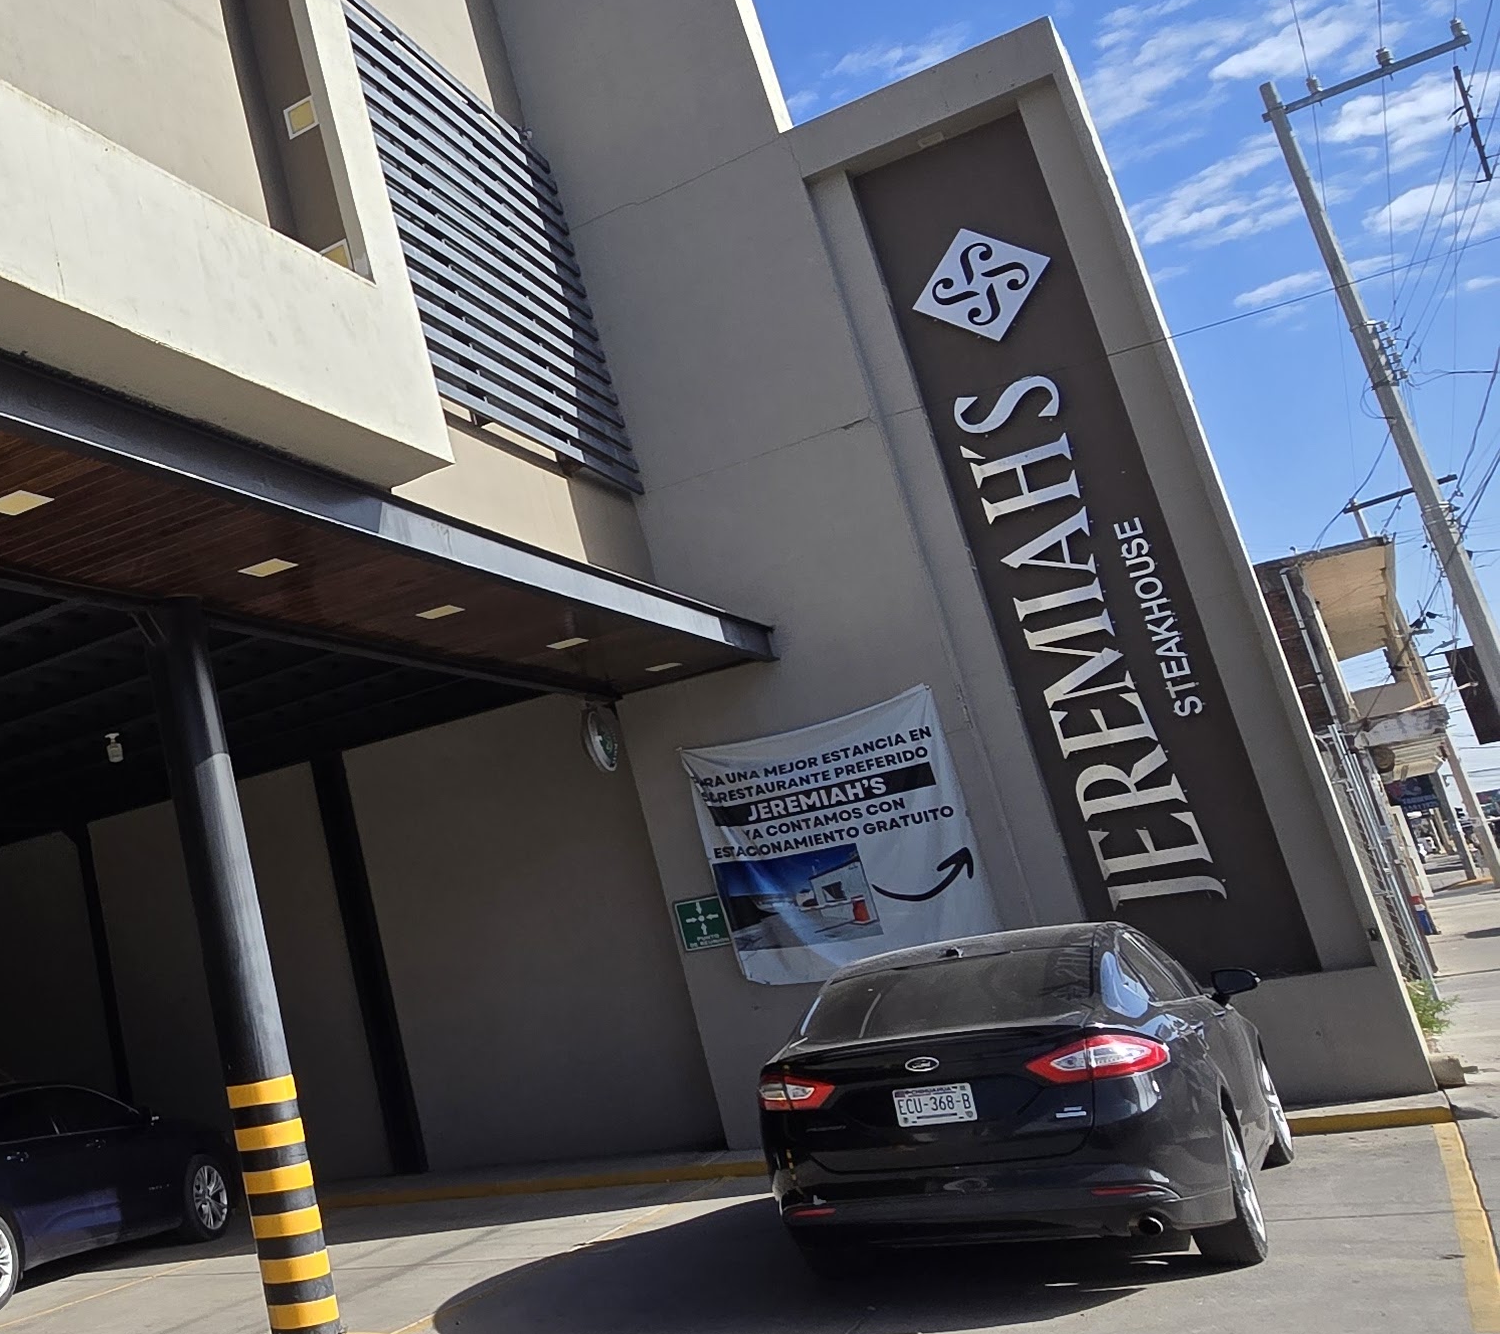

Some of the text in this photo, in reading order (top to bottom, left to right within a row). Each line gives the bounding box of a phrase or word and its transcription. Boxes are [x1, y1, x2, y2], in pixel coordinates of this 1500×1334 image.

[1113, 516, 1204, 717] STEAKHOUSE
[953, 374, 1228, 912] JEREMIAH'S
[690, 725, 932, 788] RA UNA MEJOR ESTANCIA EN
[717, 769, 832, 803] RESTAURANTE
[834, 746, 928, 778] PREFERIDO
[741, 797, 906, 841] YA CONTAMOS CON
[748, 777, 887, 822] JEREMIAH'S
[863, 805, 954, 835] GRATUITO
[897, 1093, 972, 1116] ECU-368-B
